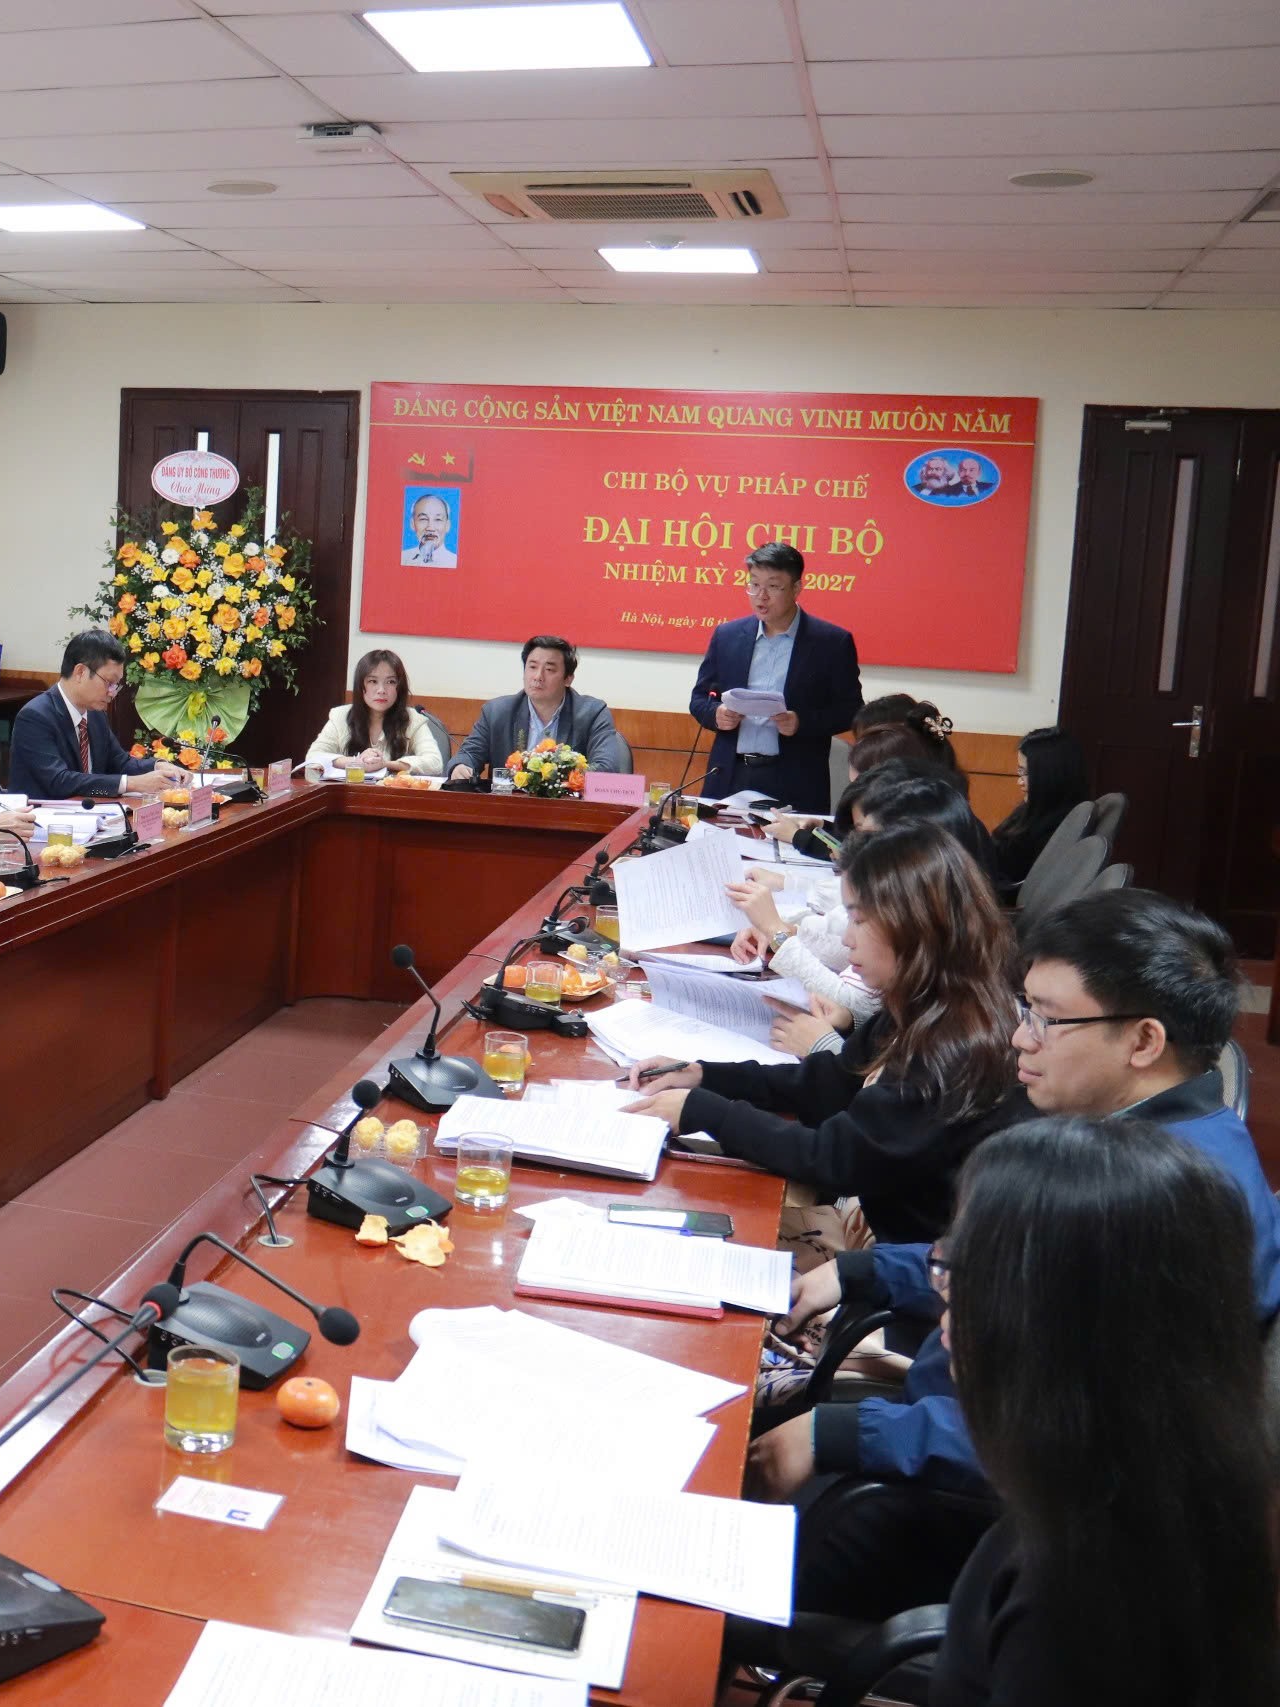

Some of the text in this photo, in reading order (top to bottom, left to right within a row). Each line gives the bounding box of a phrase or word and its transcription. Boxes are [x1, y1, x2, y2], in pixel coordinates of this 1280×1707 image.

[394, 391, 1012, 434] ĐẢNG CỘNG SẢN VIỆT NAM QUANG VINH MUÔN NĂM
[603, 468, 870, 499] CHI BỘ VỤ PHÁP CHẾ
[583, 512, 884, 565] ĐẠI HỘI CHI BỘ
[603, 559, 687, 587] NHIỆM
[695, 562, 728, 587] KỲ
[804, 572, 856, 592] 2027
[620, 611, 638, 623] Hà
[640, 612, 664, 627] Nội,
[667, 615, 697, 629] ngày
[700, 617, 714, 628] 16
